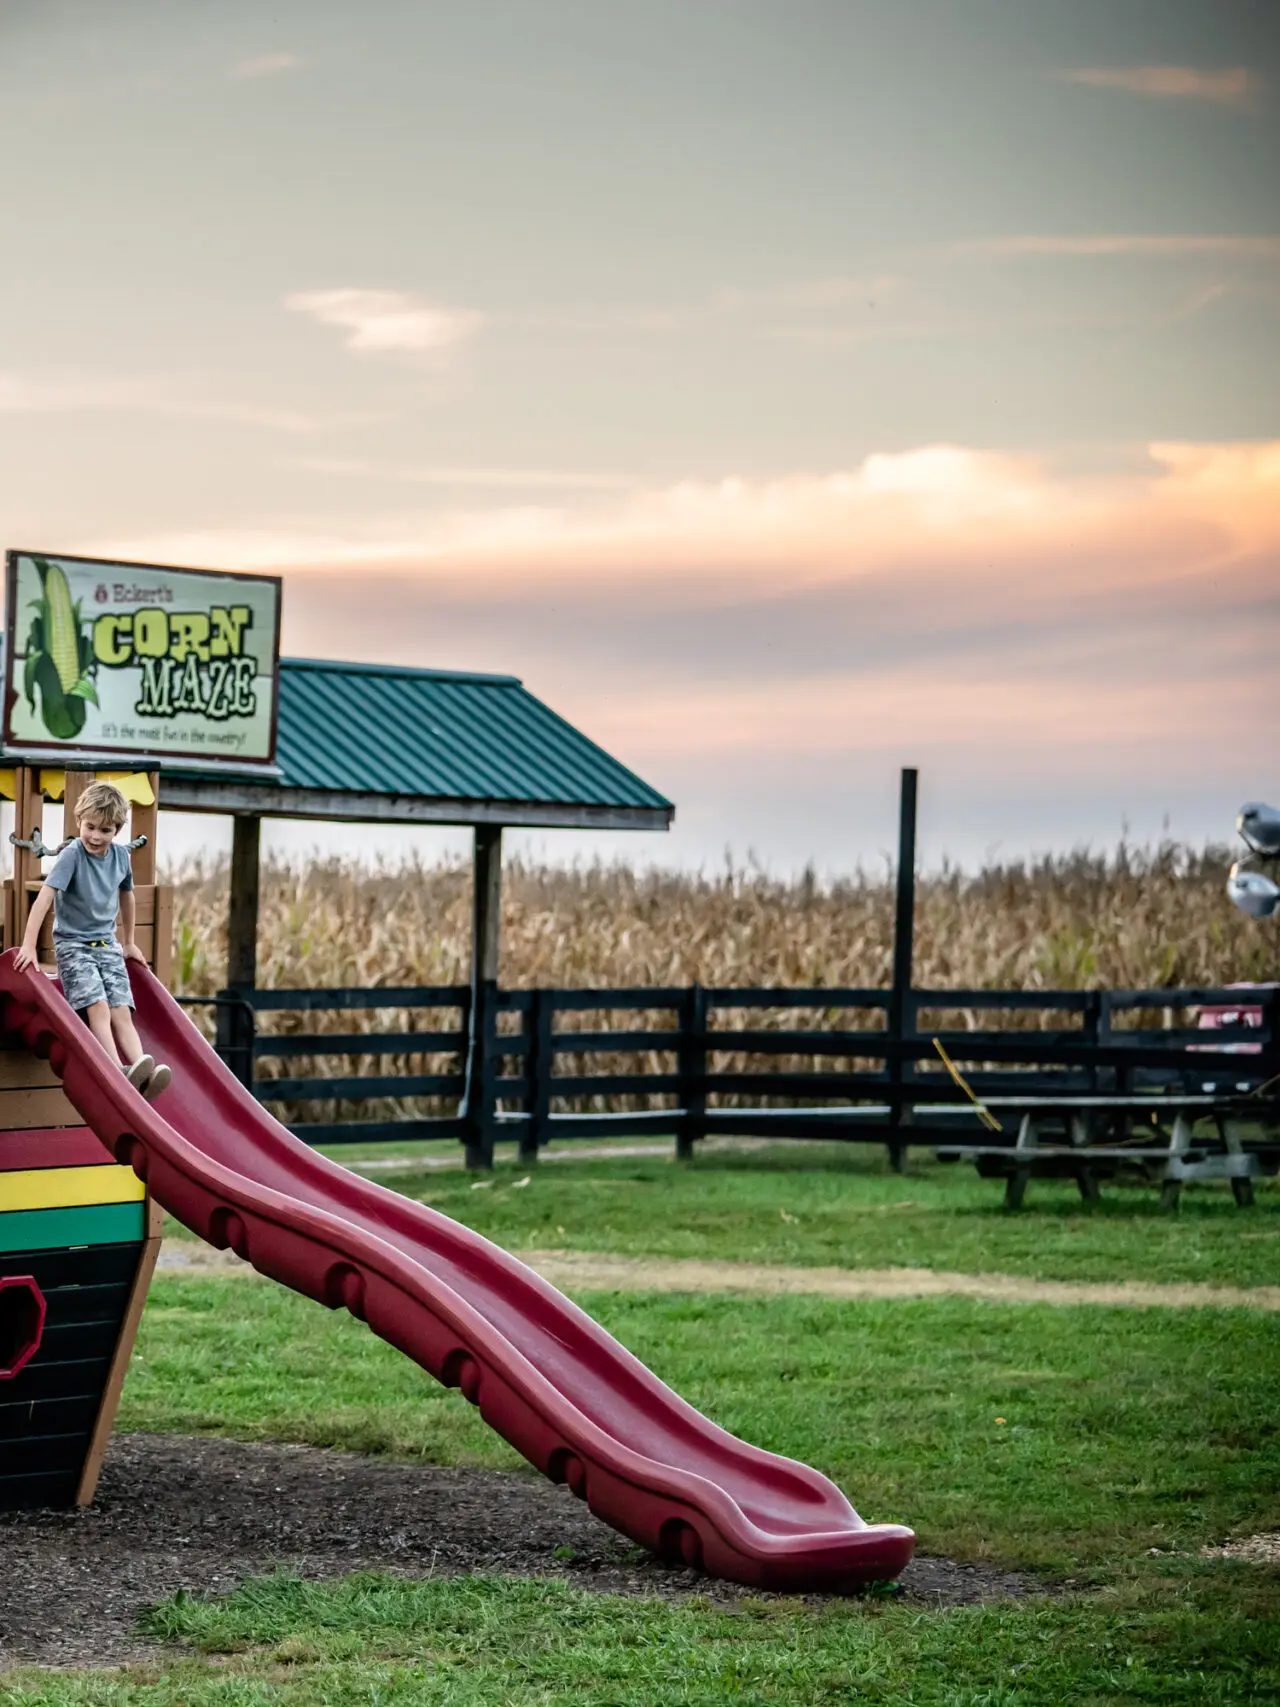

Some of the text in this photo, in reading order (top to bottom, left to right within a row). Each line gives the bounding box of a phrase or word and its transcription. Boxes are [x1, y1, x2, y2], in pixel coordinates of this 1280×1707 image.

[112, 583, 174, 603] Eckert's
[93, 605, 252, 667] CORN
[137, 652, 257, 719] MAZE
[121, 724, 135, 739] the
[163, 725, 177, 742] fun
[180, 727, 188, 741] in
[190, 727, 205, 743] the
